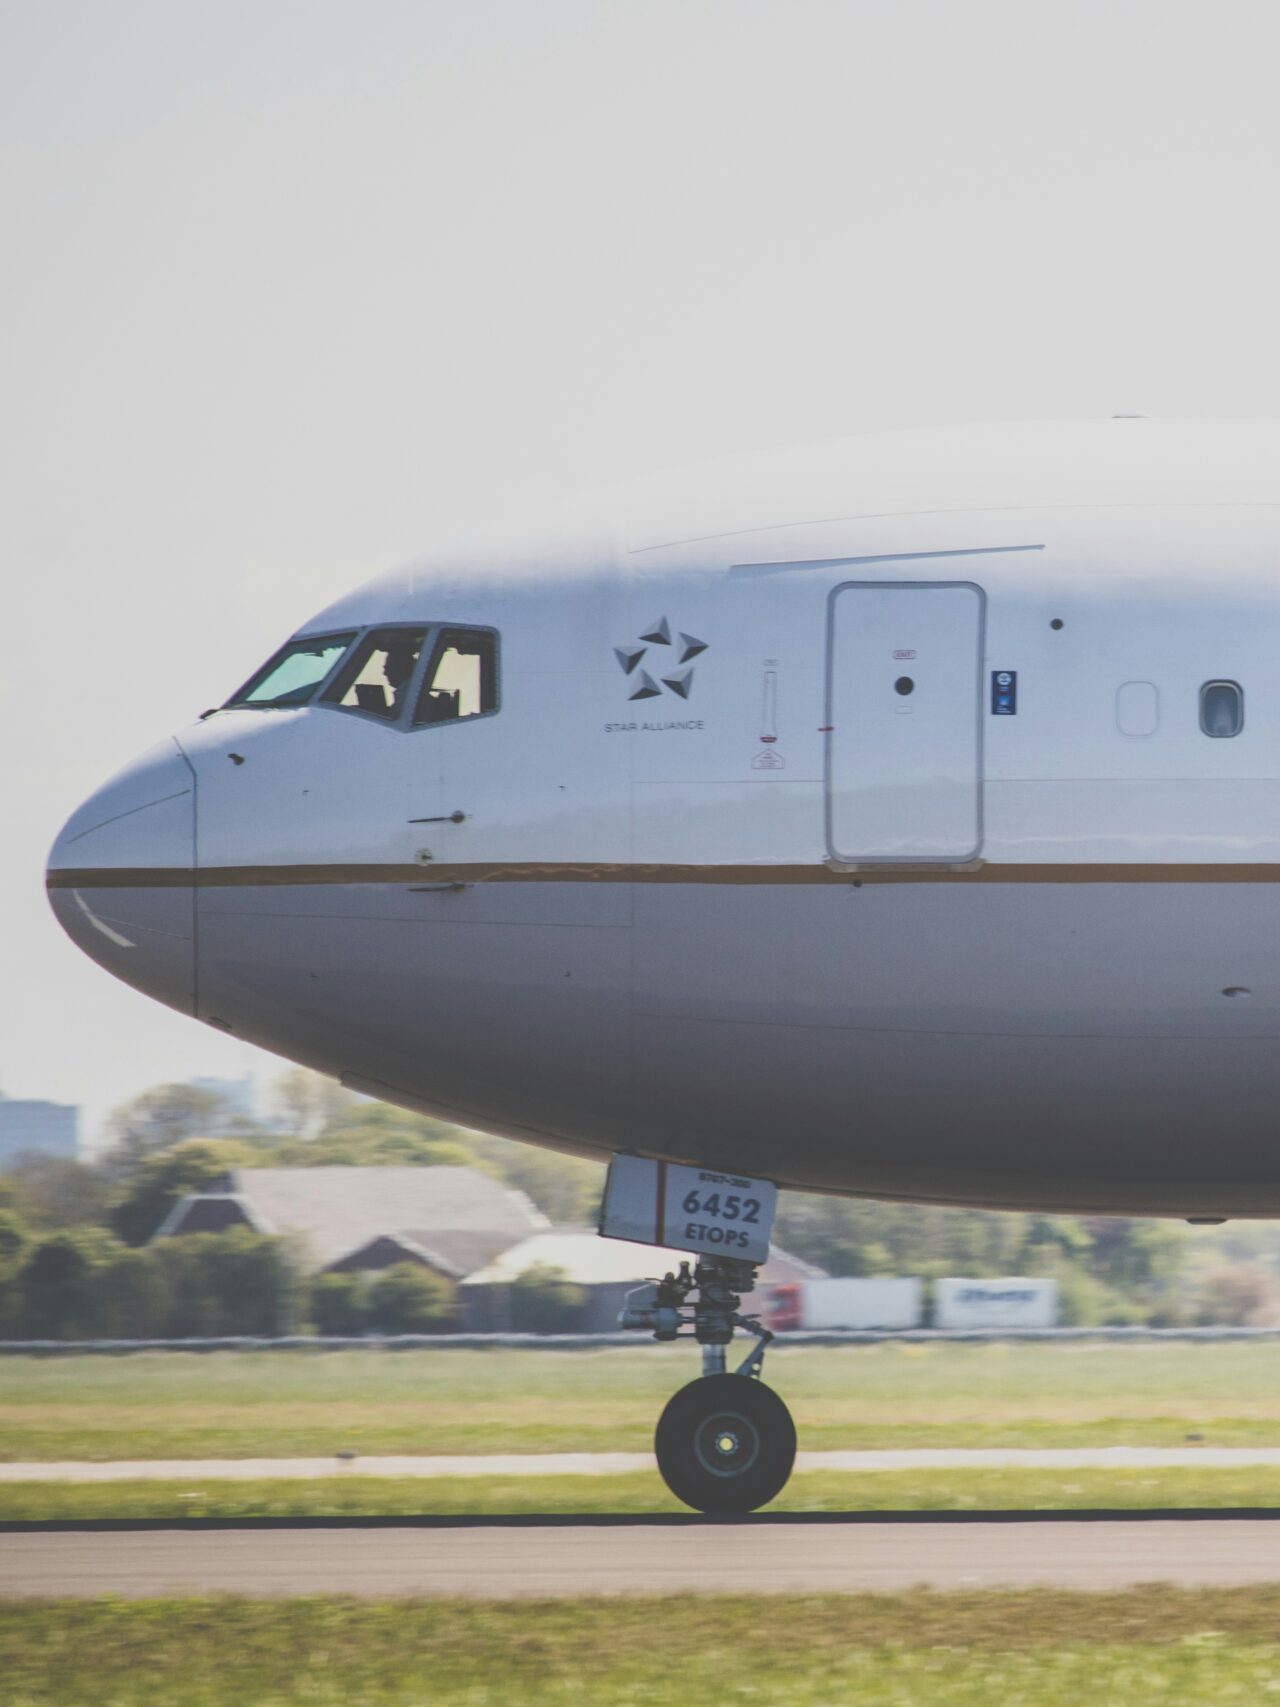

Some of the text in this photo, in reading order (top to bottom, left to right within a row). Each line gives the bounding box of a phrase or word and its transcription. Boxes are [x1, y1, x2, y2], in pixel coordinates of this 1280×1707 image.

[604, 719, 705, 733] STAR ALLIANCE
[682, 1190, 761, 1224] 6452
[685, 1223, 749, 1247] ETOPS
